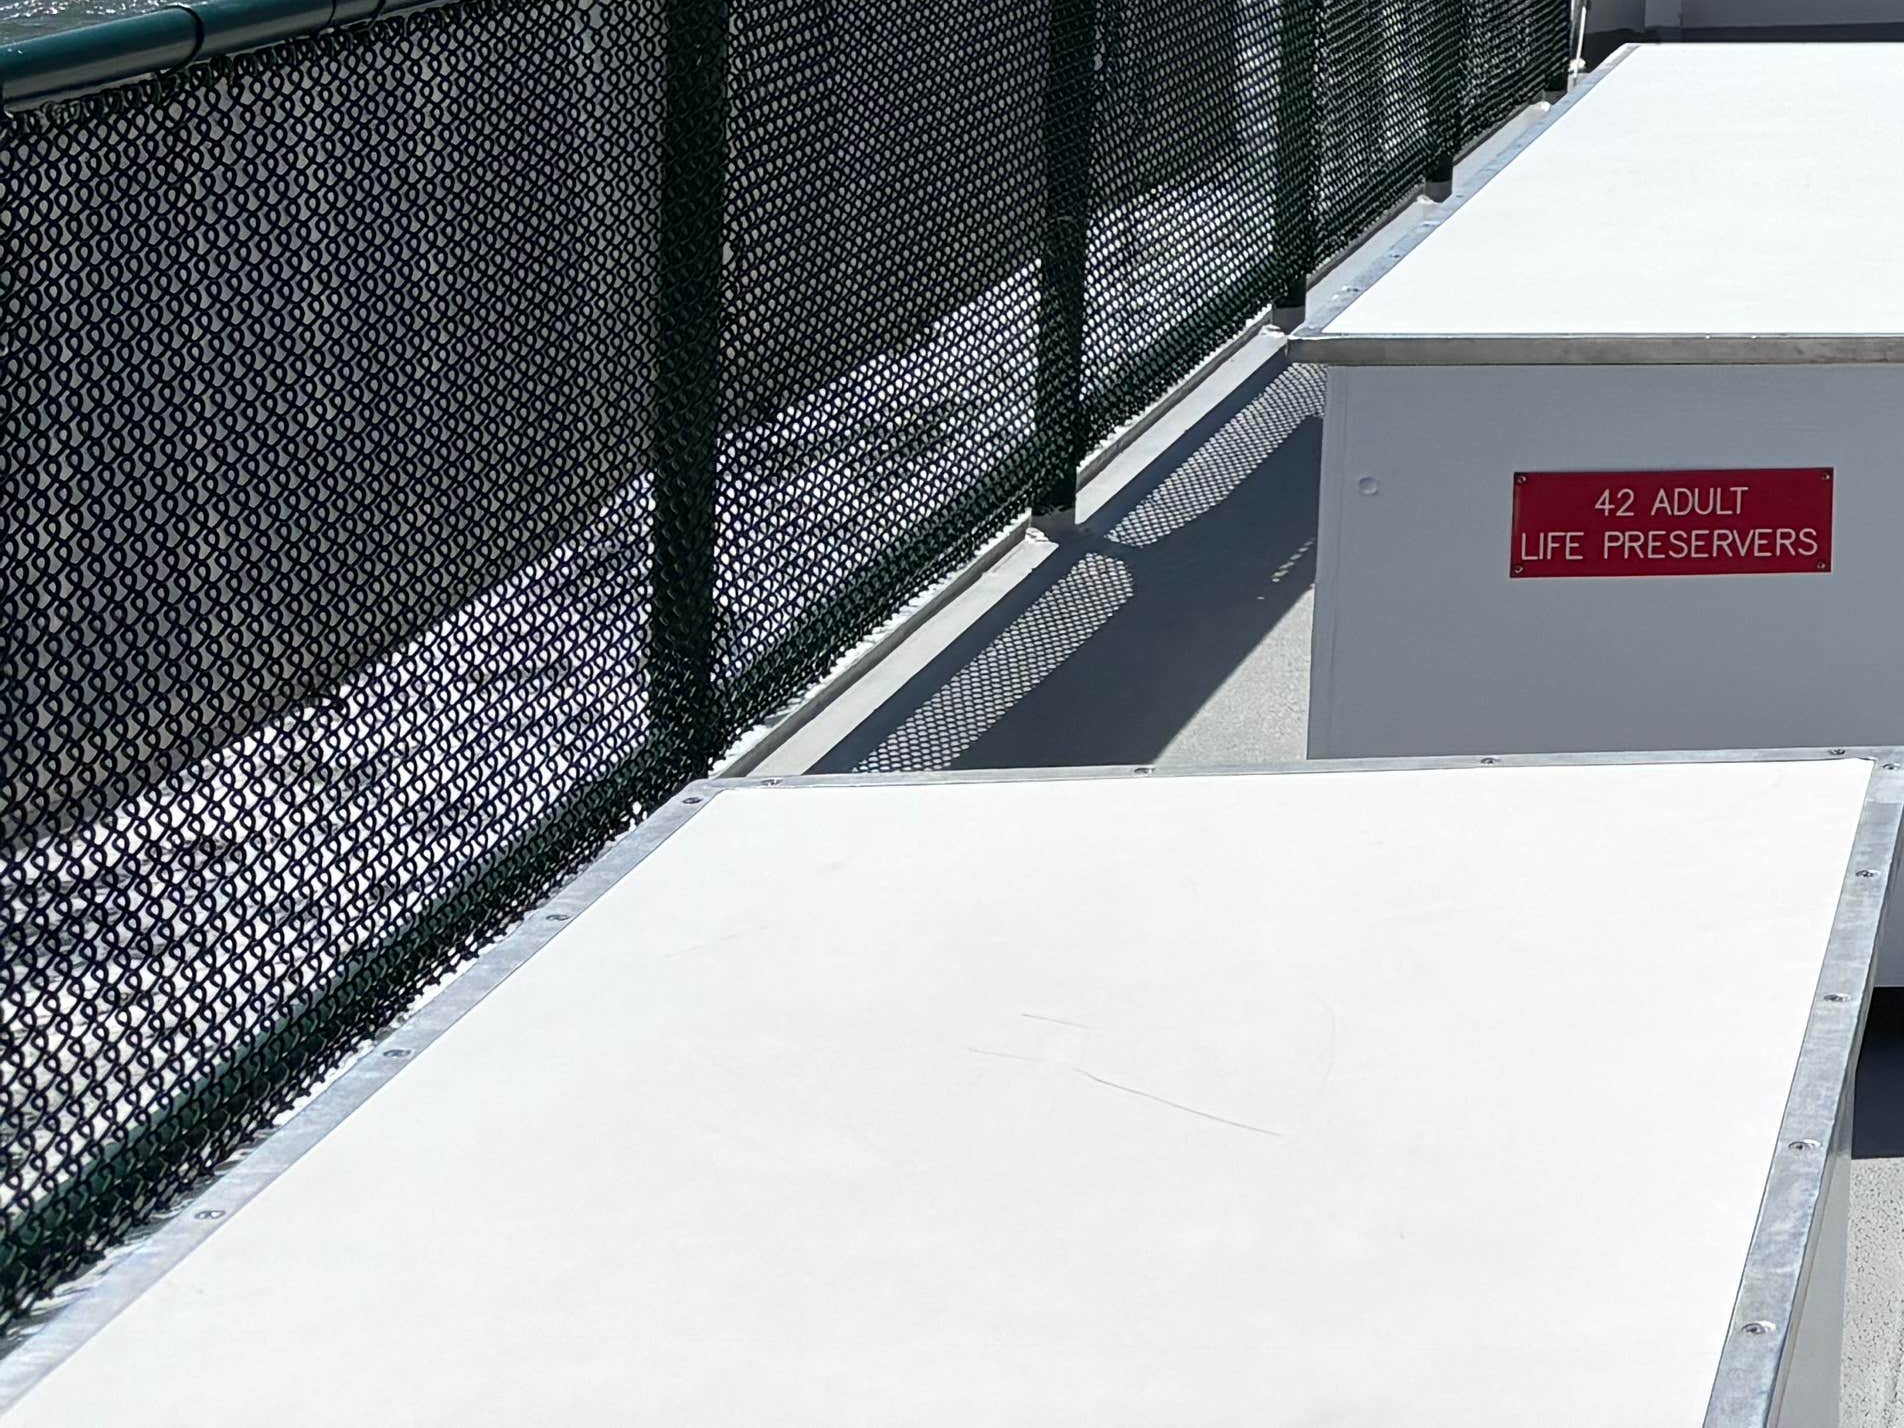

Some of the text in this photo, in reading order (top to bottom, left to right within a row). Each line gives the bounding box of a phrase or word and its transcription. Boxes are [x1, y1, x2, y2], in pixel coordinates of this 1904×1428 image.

[1594, 486, 1750, 517] 42 ADULT
[1520, 527, 1819, 561] LIFE PRESERVERS
